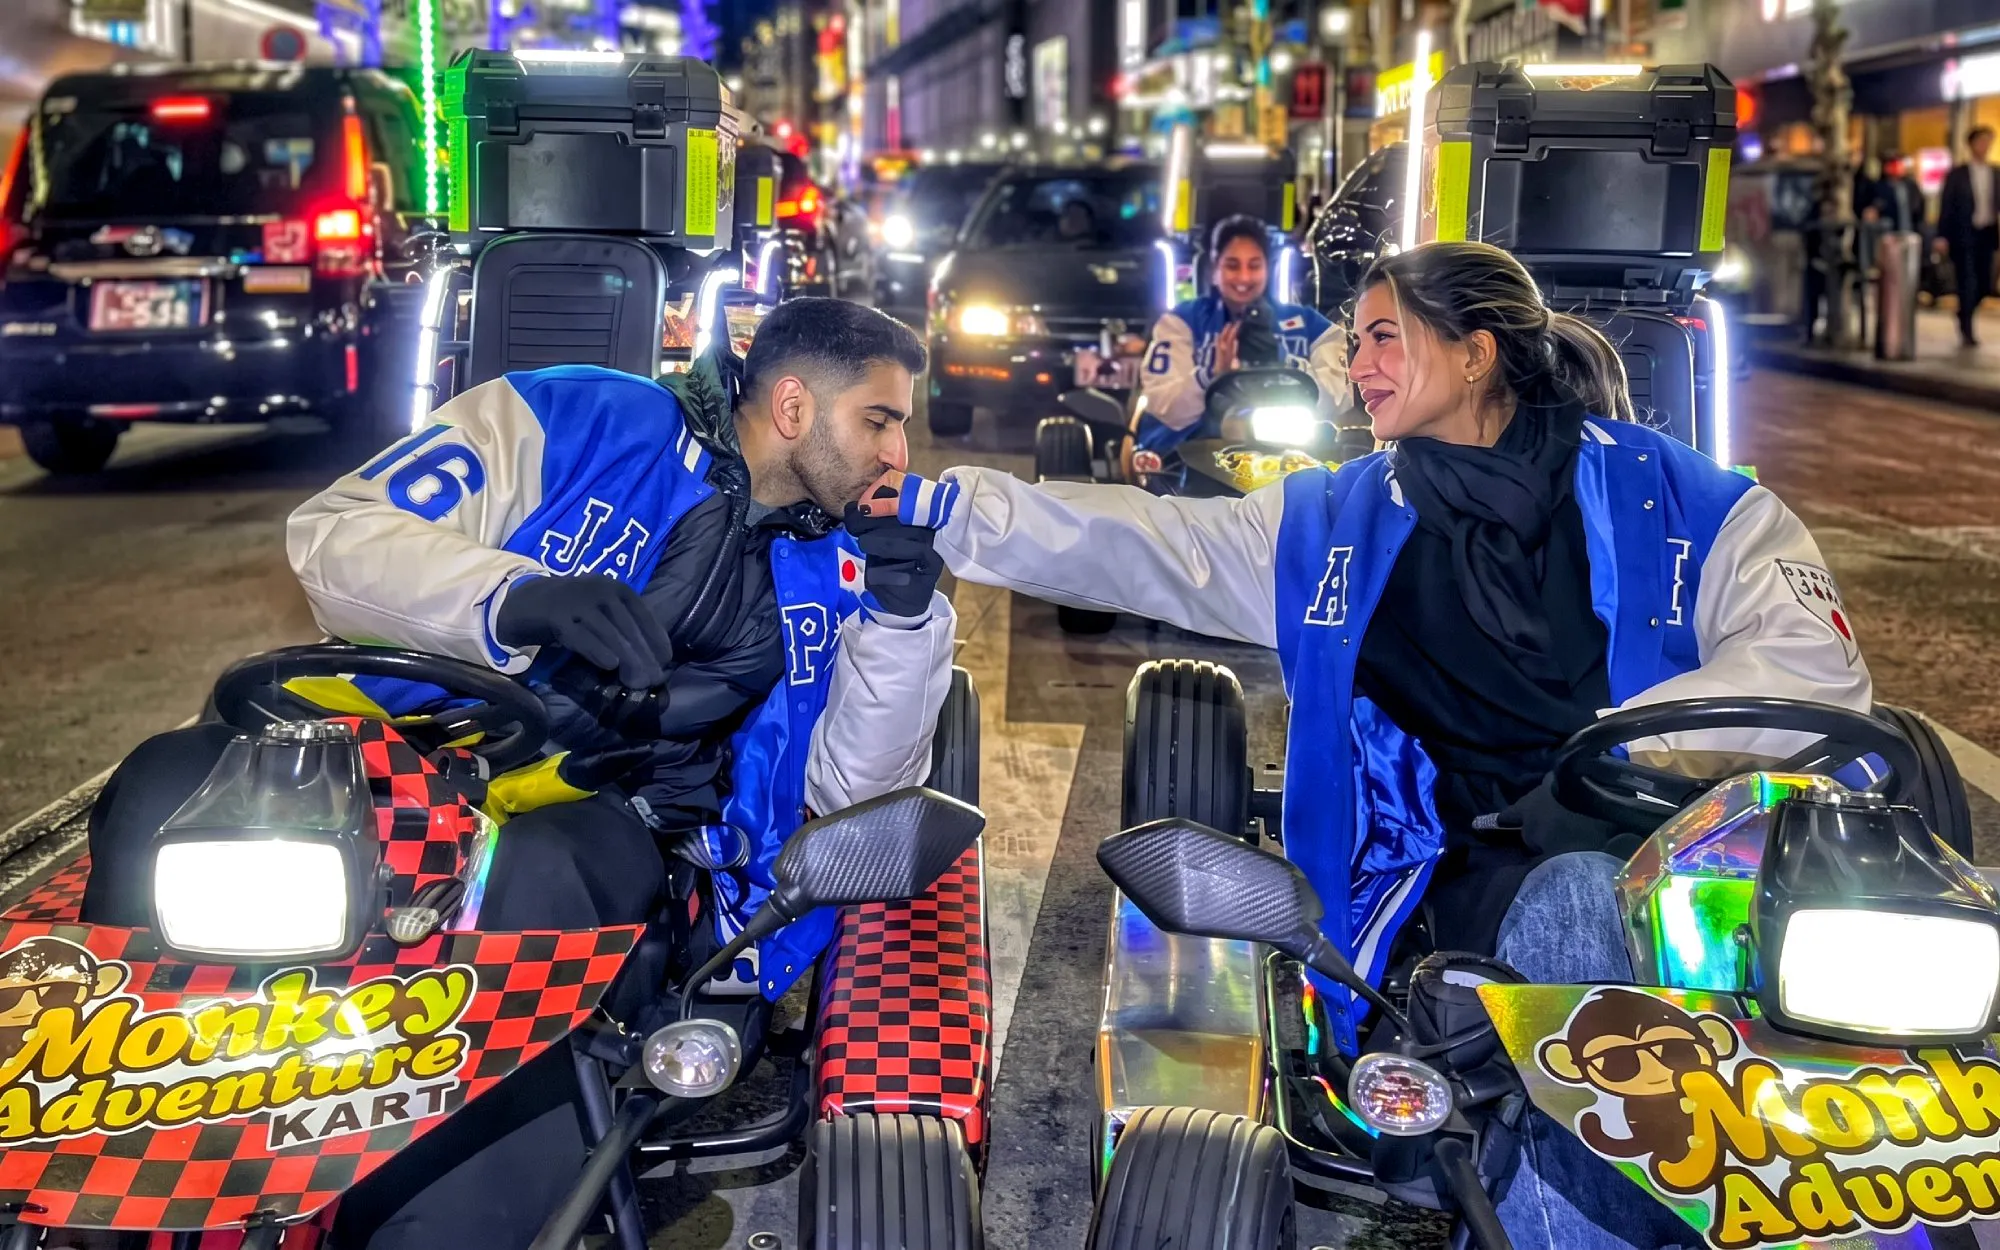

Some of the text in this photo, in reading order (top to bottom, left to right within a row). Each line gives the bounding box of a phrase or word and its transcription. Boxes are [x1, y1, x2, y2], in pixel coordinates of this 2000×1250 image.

[360, 424, 486, 522] 16
[781, 603, 841, 686] P
[0, 971, 467, 1088] Monkey
[0, 1037, 460, 1138] Adventure
[270, 1081, 455, 1148] KART
[1658, 1048, 2000, 1187] Monk
[1719, 1162, 2000, 1243] Adven
